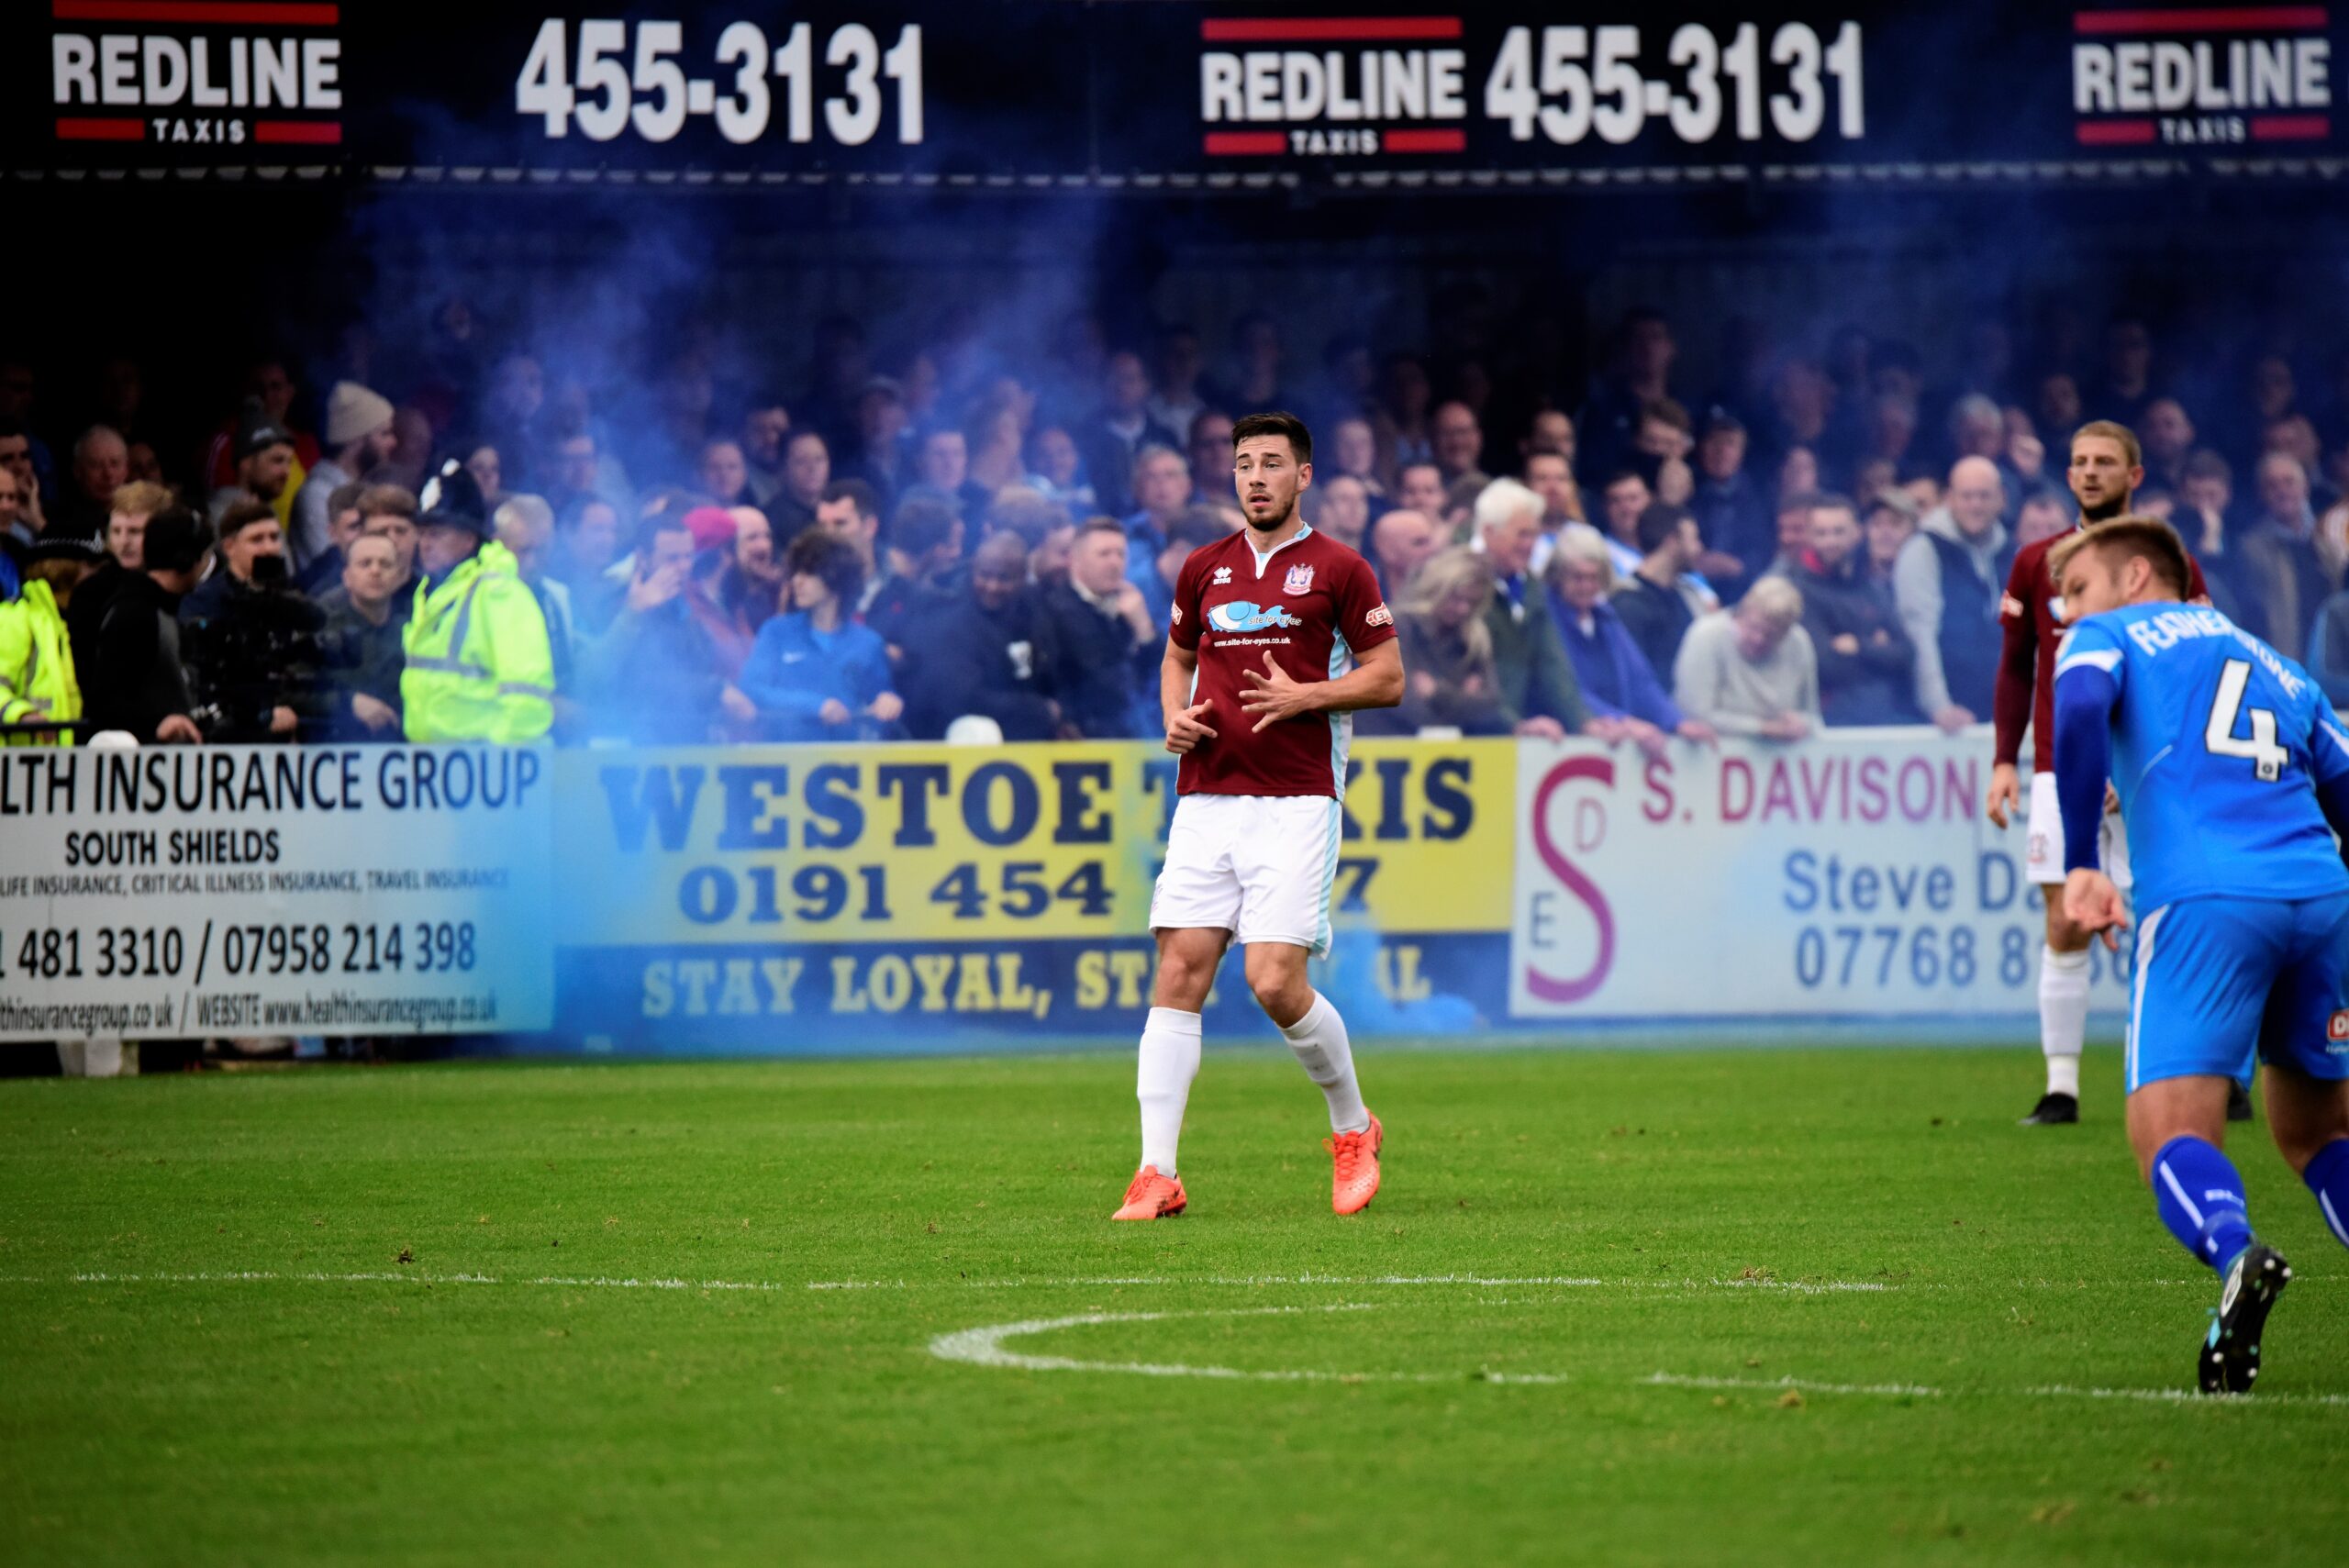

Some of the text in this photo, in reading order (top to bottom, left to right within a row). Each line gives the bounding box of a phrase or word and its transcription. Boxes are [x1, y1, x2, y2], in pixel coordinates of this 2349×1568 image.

[52, 33, 342, 109] REDLINE
[515, 17, 924, 146] 455-3131
[1201, 50, 1466, 121] REDLINE
[1485, 21, 1865, 143] 455-3131
[2072, 37, 2332, 113] REDLINE
[152, 118, 246, 144] TAXIS
[1288, 130, 1378, 156] TAXIS
[2160, 116, 2247, 144] TAXIS
[1249, 616, 1302, 626] site for eyes
[2204, 657, 2289, 783] 4
[1, 748, 540, 816] LTH INSURANCE GROUP
[599, 761, 1114, 852] WESTOE
[1640, 758, 1693, 823] S.
[1720, 757, 1978, 824] DAVISON
[64, 828, 281, 866] SOUTH SHIELDS
[33, 873, 128, 898] INSURANCE,
[131, 872, 201, 895] CRITICAL
[206, 871, 265, 895] ILLNESS
[366, 869, 420, 892] TRAVEL
[678, 865, 893, 924] 0191
[929, 860, 1116, 919] 454
[1782, 850, 1956, 912] Steve
[17, 927, 83, 980] 481
[95, 926, 184, 977] 3310
[222, 924, 330, 974] 07958
[341, 923, 404, 973] 214
[415, 921, 477, 972] 398
[1794, 926, 1977, 988] 07768
[197, 993, 261, 1029] WEBSITE
[642, 956, 805, 1018] STAY
[829, 951, 1052, 1019] LOYAL,
[1075, 949, 1230, 1009] ST
